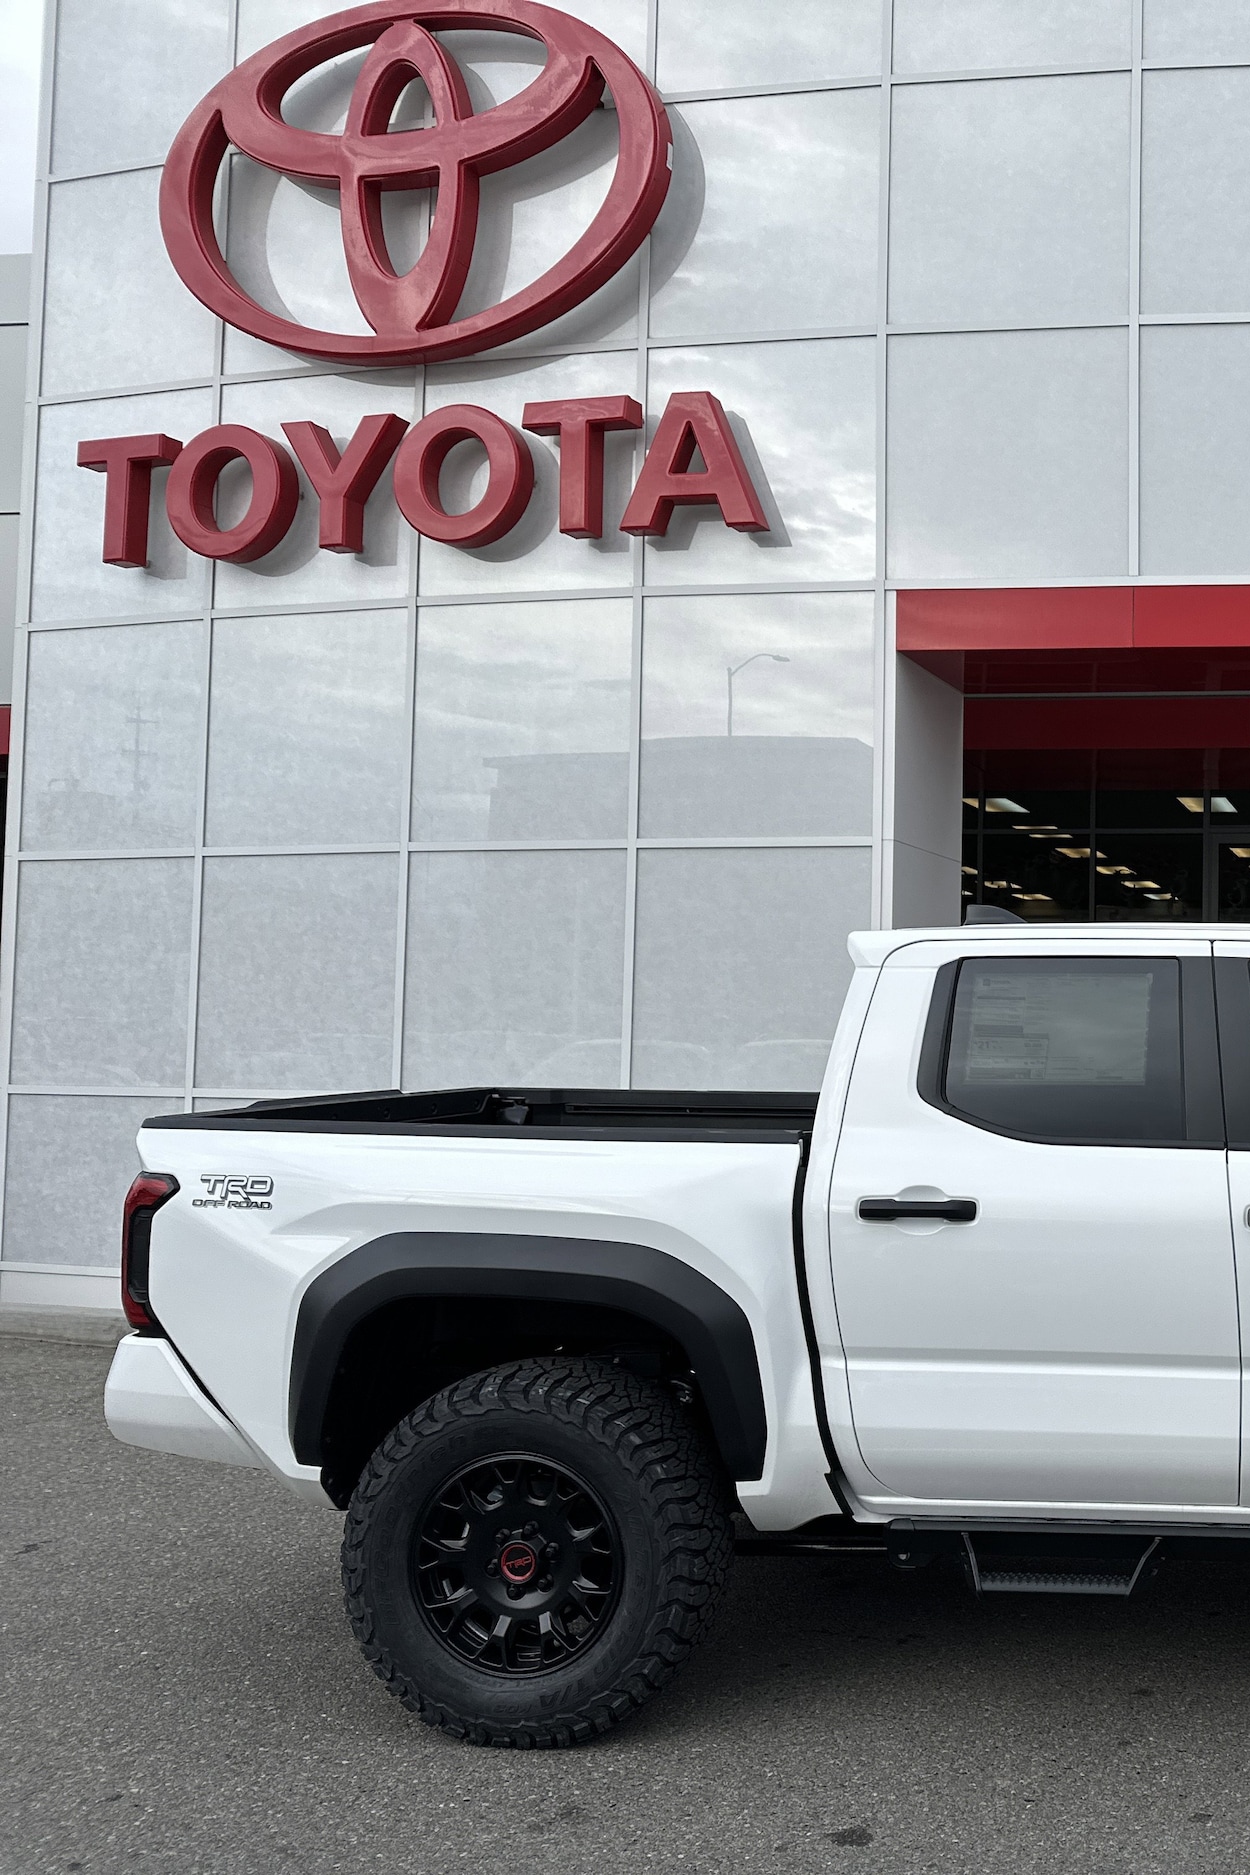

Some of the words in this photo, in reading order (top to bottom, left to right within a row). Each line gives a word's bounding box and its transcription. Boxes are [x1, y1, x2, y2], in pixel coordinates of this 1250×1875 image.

[77, 391, 770, 568] TOYOTA
[201, 1174, 274, 1199] TRD
[192, 1199, 225, 1209] OFF
[227, 1200, 272, 1210] ROAD
[506, 1556, 531, 1568] TRD
